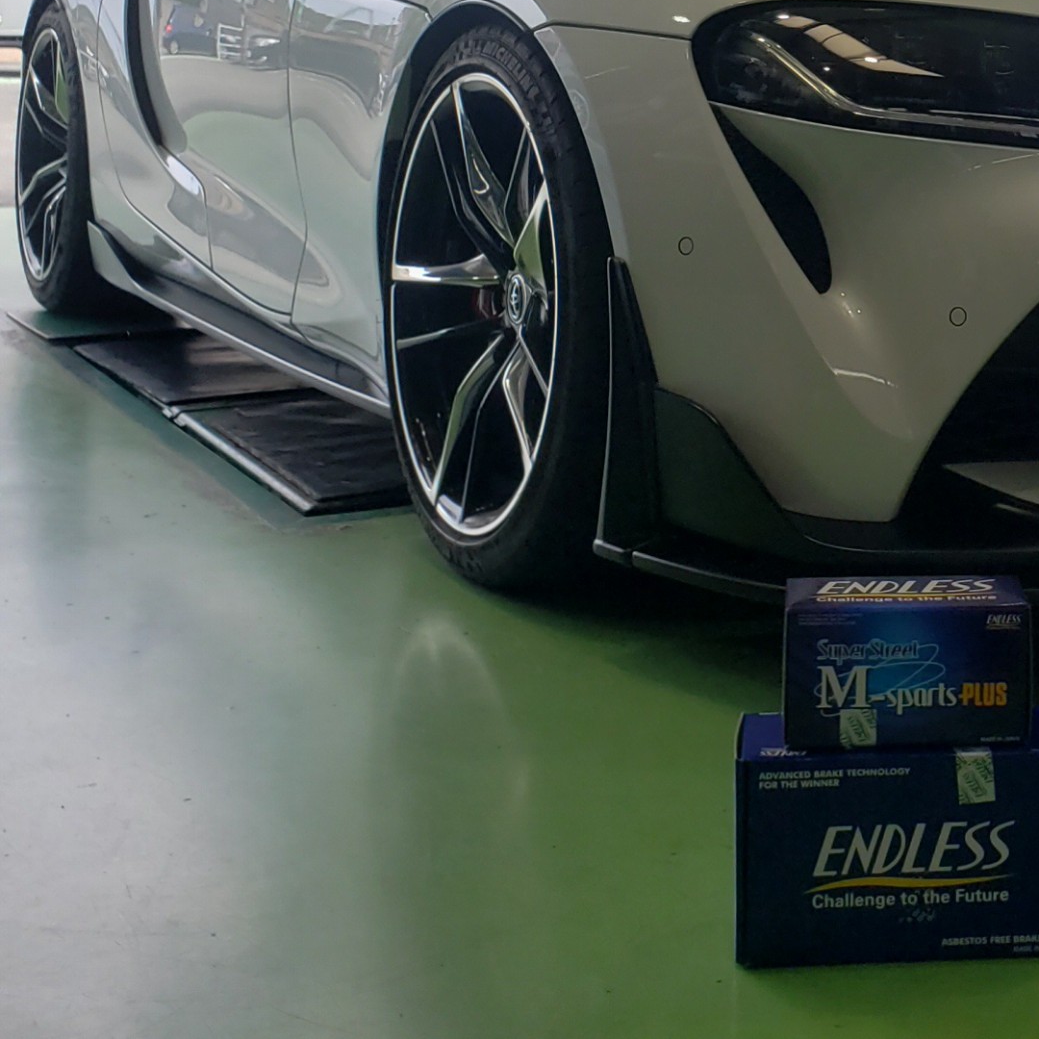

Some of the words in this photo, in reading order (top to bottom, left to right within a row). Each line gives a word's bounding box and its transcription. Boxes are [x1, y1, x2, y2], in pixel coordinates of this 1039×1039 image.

[817, 578, 997, 594] ENDLESS
[816, 595, 893, 603] Challenge
[947, 594, 998, 602] Future
[985, 613, 1022, 625] ENDLESS
[758, 770, 811, 780] ADVANCED
[813, 769, 844, 779] BRAKE
[846, 767, 911, 777] TECHNOLOGY
[758, 780, 778, 790] FOR
[780, 780, 798, 789] THE
[800, 779, 840, 788] WINNER
[812, 820, 1015, 878] ENDLESS
[812, 892, 896, 910] Challenge
[900, 892, 918, 906] to
[923, 889, 951, 905] the
[955, 888, 1010, 903] Future
[941, 936, 988, 946] ASBESTOS
[990, 935, 1011, 944] FREE
